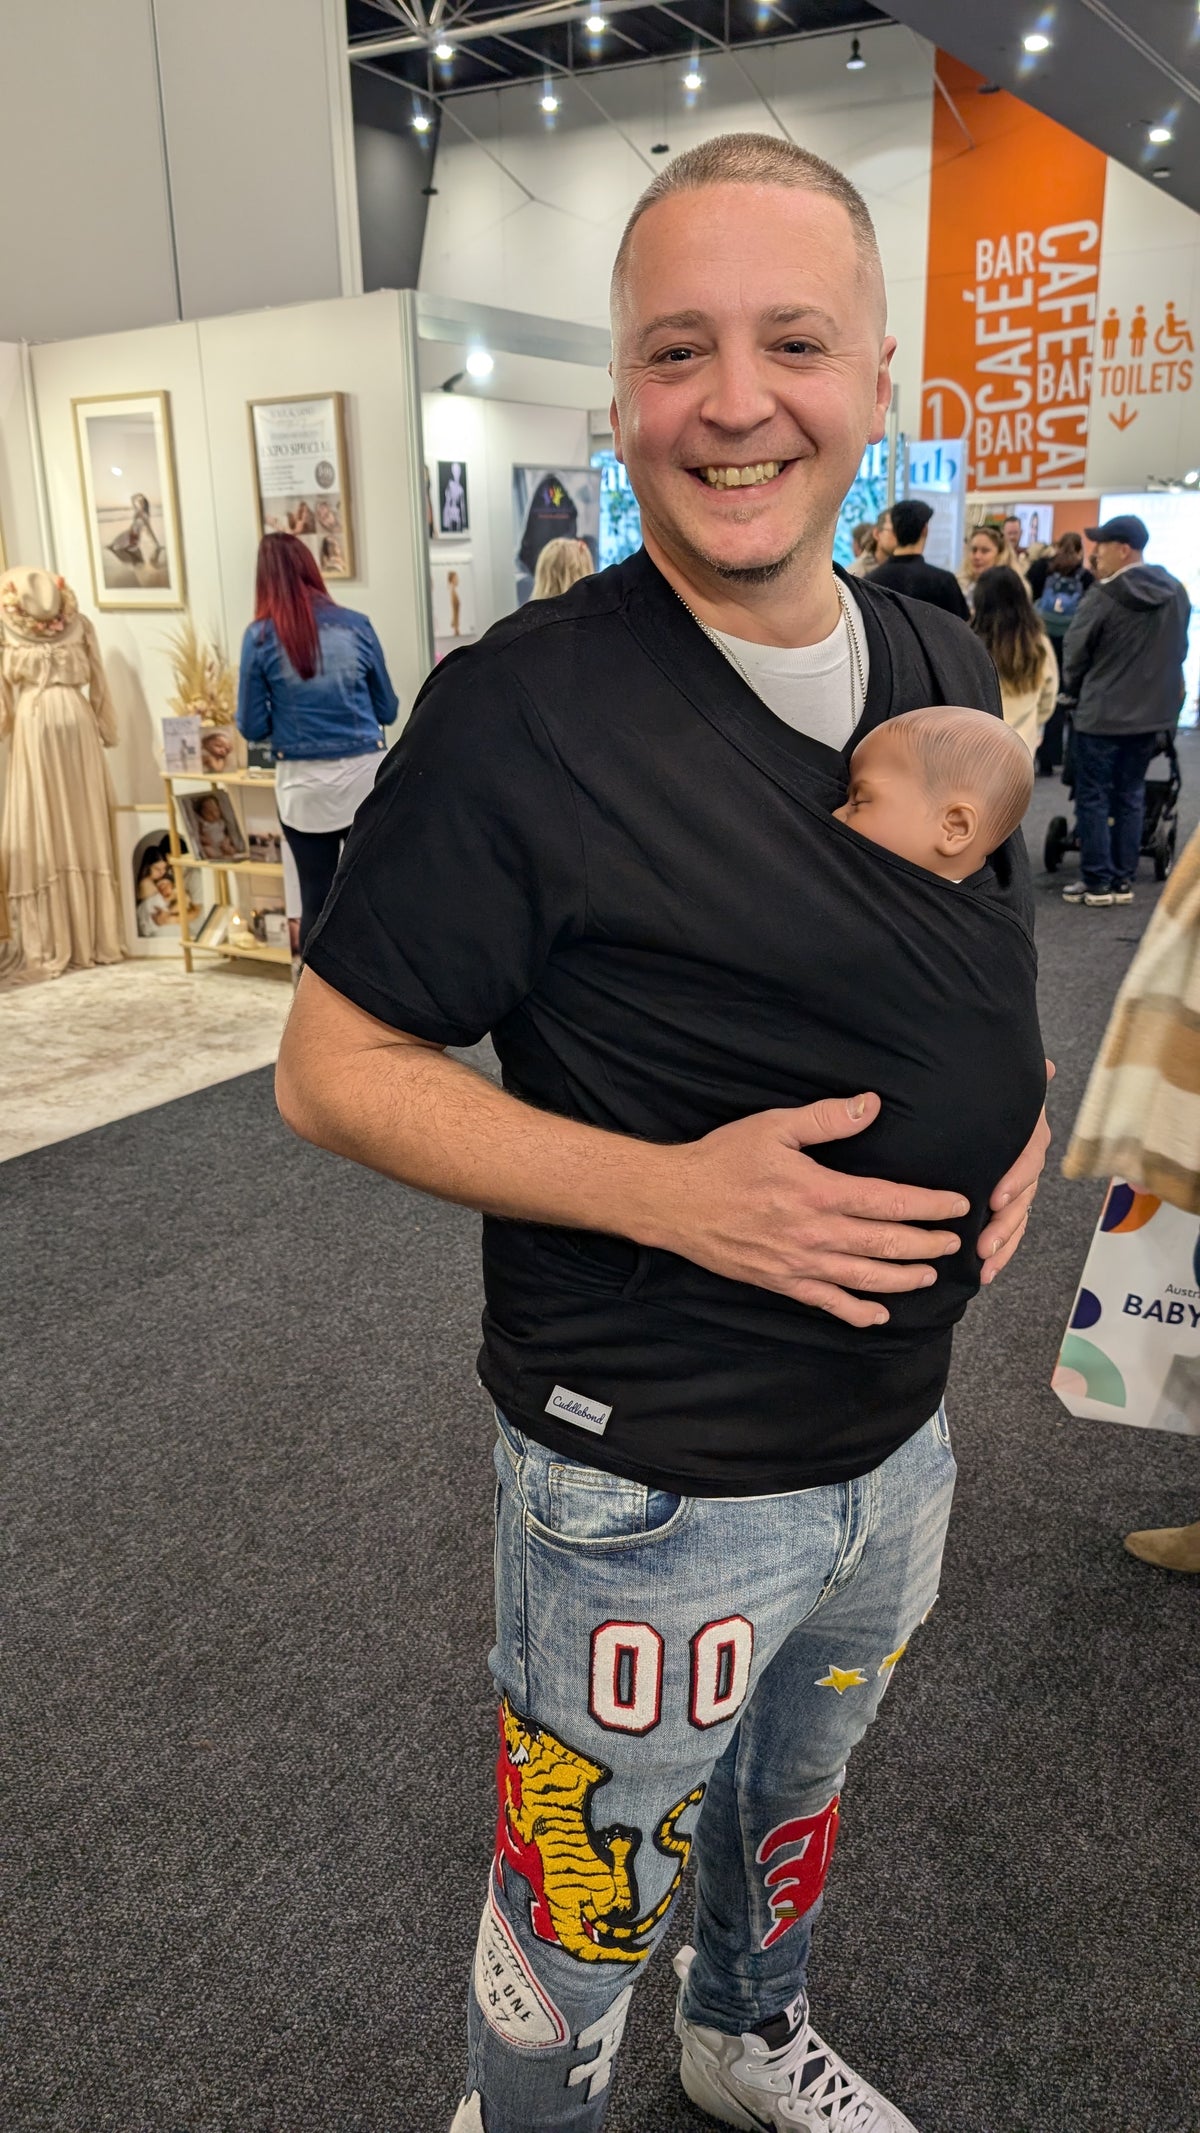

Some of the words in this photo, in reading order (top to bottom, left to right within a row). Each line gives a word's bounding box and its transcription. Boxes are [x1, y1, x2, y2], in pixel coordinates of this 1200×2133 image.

[976, 231, 1035, 281] BAR
[962, 277, 1033, 413] CAFÉ
[1038, 357, 1092, 404] BAR
[1099, 360, 1194, 397] TOILETS
[976, 412, 1034, 458] BAR
[1122, 1293, 1200, 1328] BABY
[552, 1395, 605, 1424] Cuddlebond
